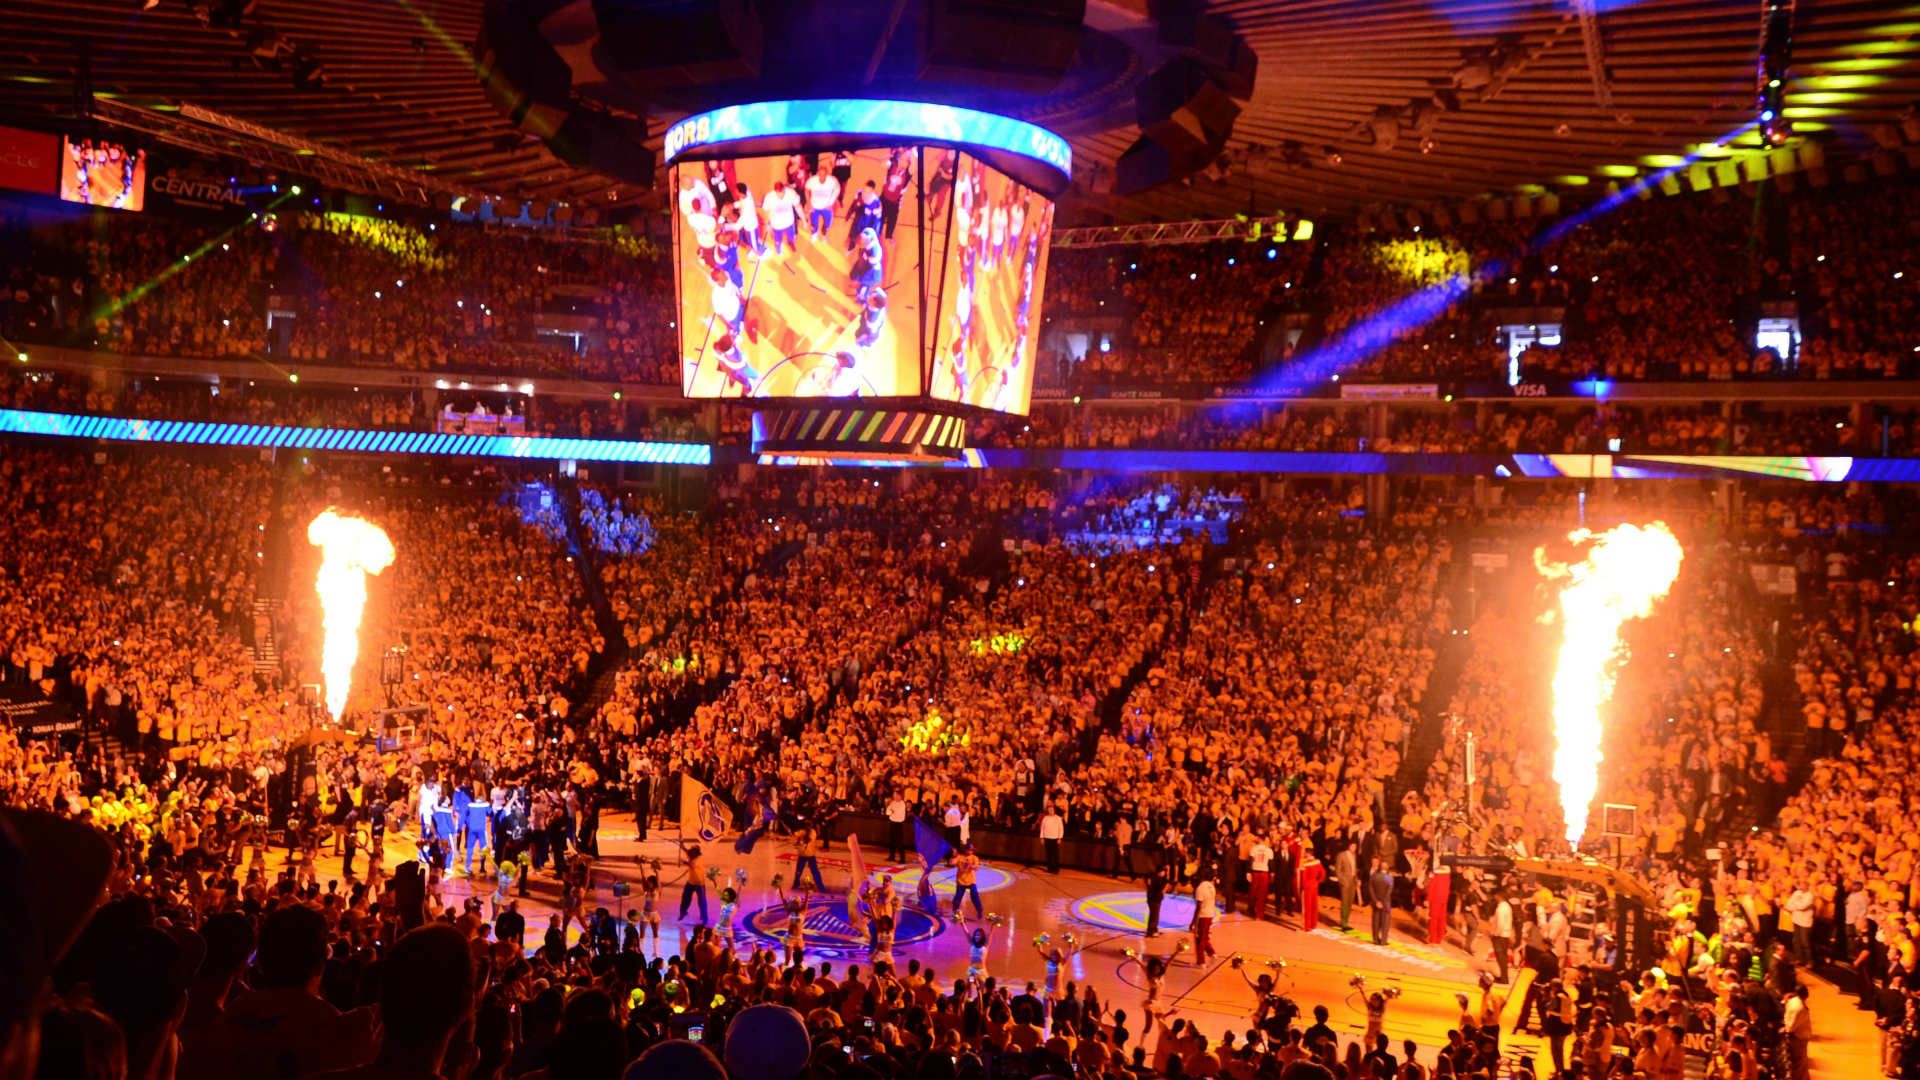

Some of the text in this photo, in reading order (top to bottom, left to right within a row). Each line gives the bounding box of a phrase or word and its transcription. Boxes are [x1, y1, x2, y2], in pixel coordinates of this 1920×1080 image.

[152, 176, 246, 206] CENTRAL
[1224, 386, 1303, 396] GOLD ALLIANCE
[1514, 384, 1547, 396] VISA
